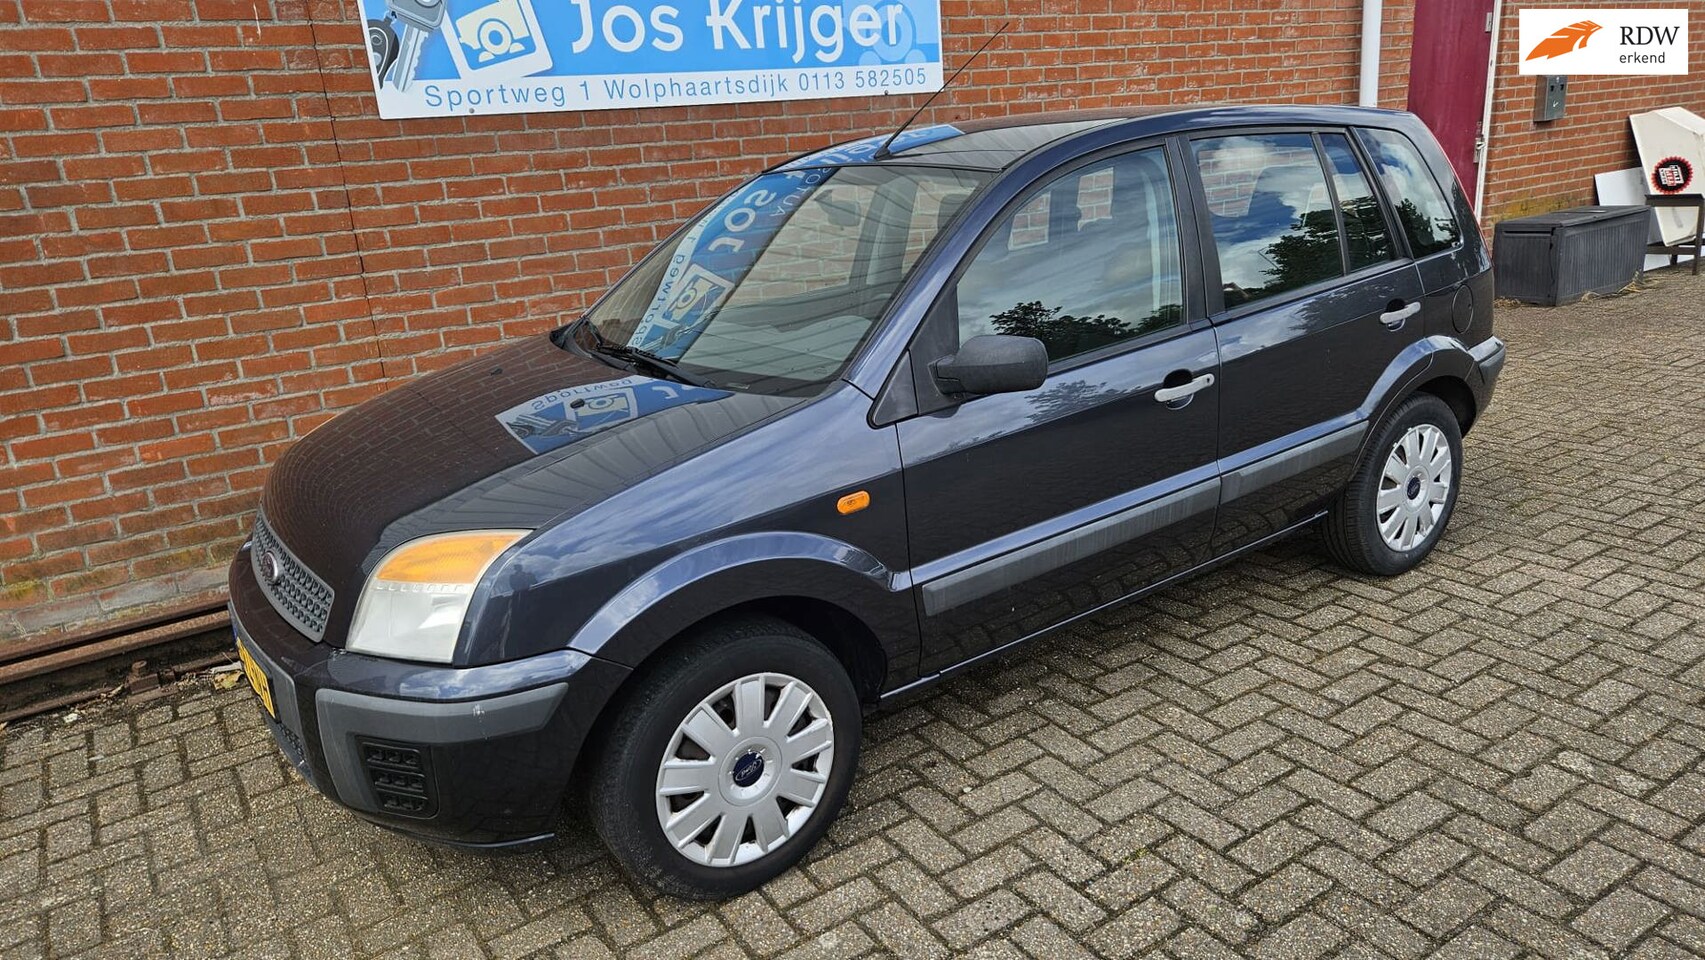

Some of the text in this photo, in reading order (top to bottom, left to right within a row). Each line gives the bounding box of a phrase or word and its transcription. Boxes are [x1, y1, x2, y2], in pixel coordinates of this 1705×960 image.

[571, 0, 903, 63] Jos Krijger
[424, 67, 927, 111] Sportweg 1 Wolphaartsdijk 0113 582505
